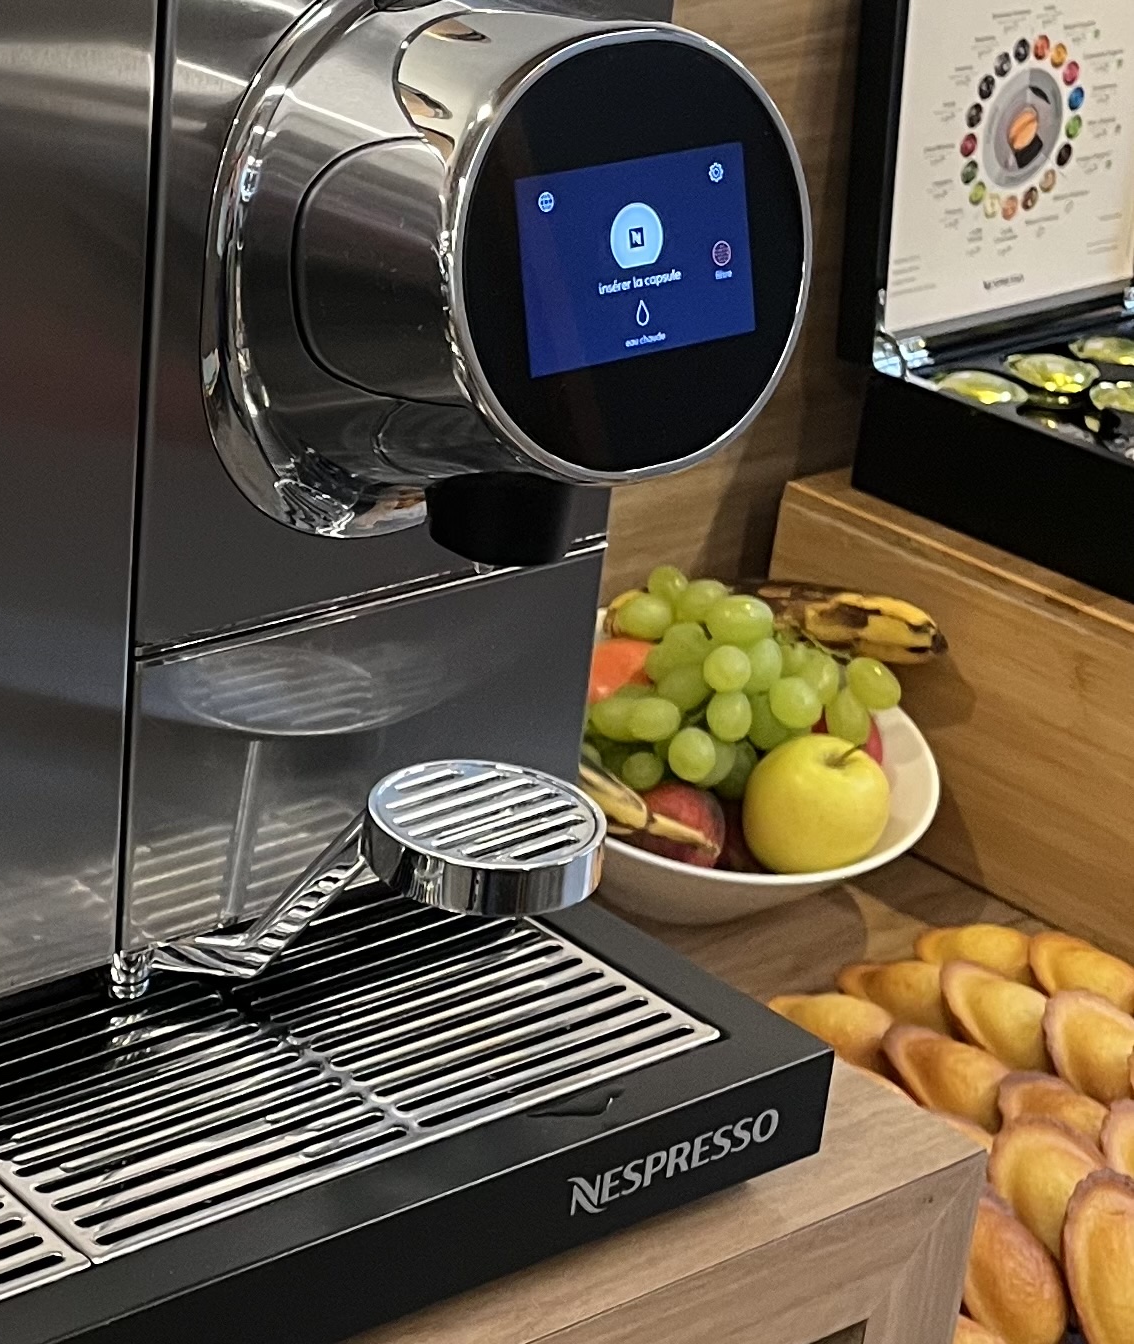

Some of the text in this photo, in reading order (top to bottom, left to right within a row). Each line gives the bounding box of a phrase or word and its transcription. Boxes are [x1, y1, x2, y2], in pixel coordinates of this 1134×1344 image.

[598, 269, 682, 295] insérer la capsule
[566, 1108, 780, 1217] NESPRESSO
